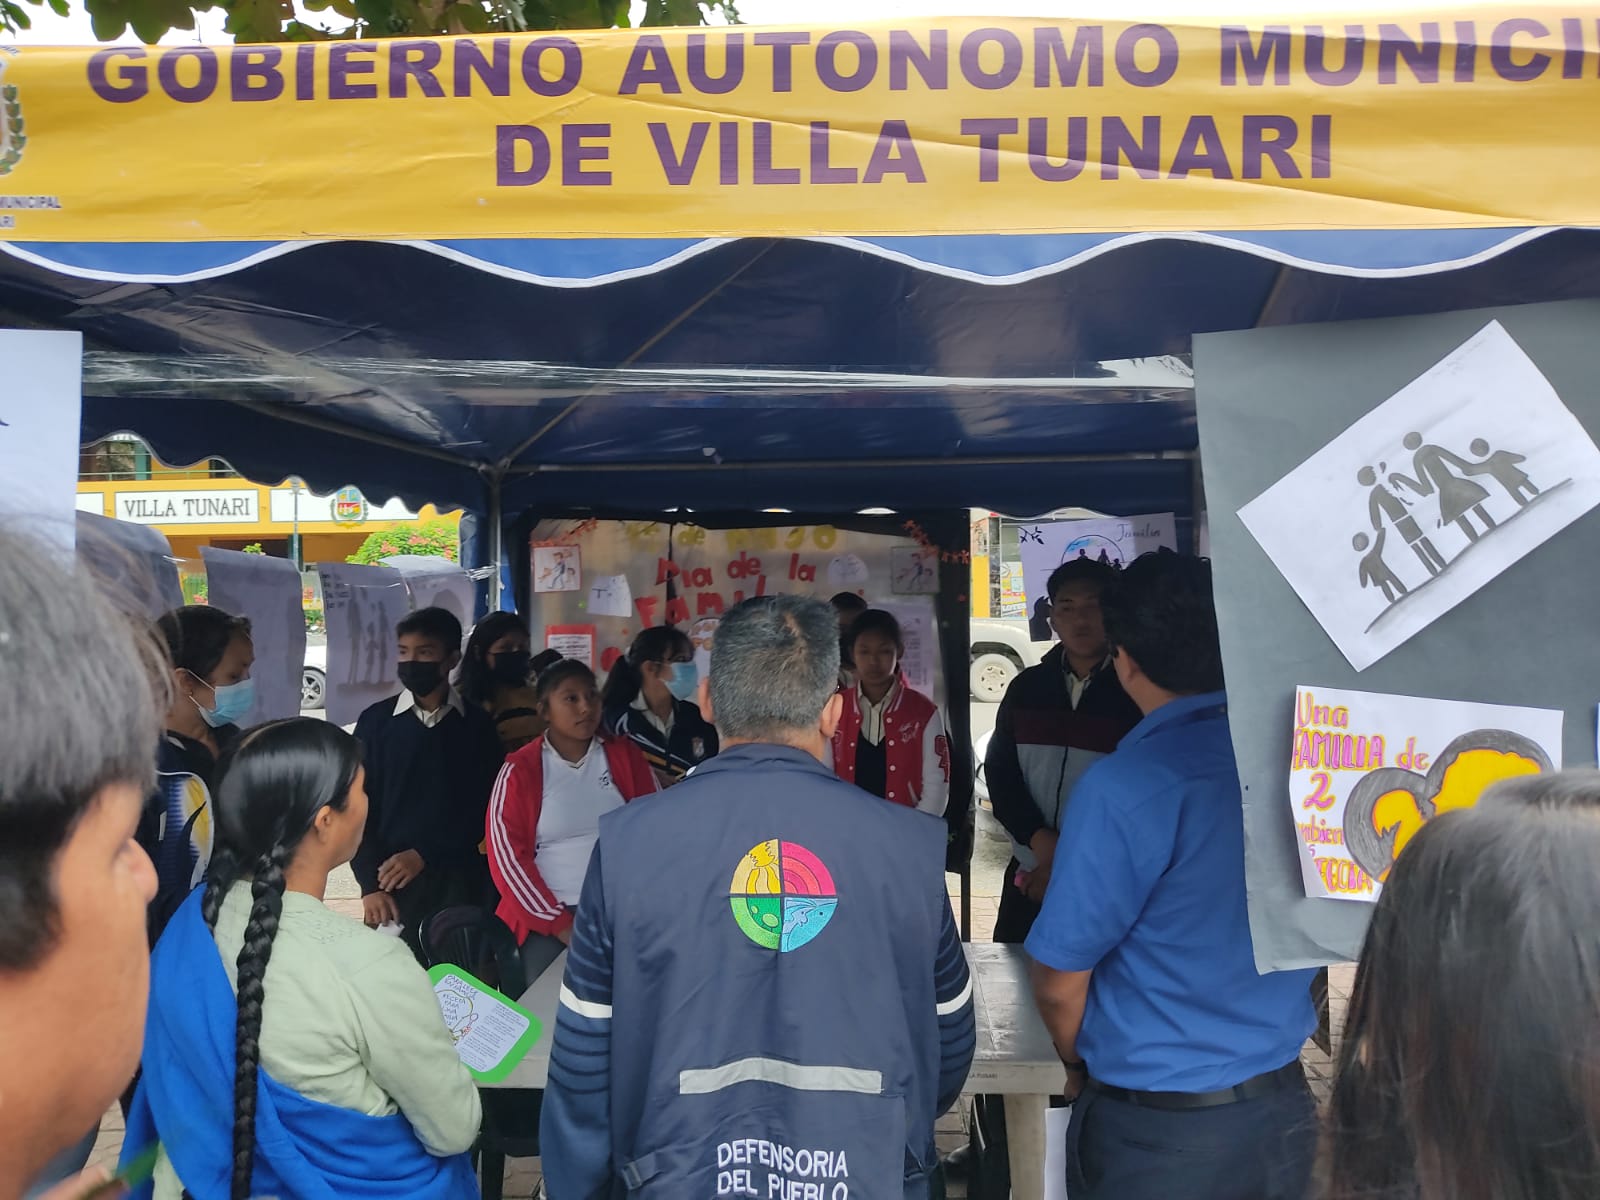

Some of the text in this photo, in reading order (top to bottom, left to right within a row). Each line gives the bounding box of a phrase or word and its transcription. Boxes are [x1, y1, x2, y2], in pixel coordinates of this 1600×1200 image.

[87, 17, 1600, 104] GOBIERNO AUTONOMO MUNICI
[496, 114, 1333, 187] DE VILLA TUNARI
[124, 498, 250, 517] VILLA TUNARI
[727, 551, 762, 580] de
[788, 553, 816, 582] la
[1297, 692, 1348, 728] Una
[1396, 736, 1429, 770] de
[1303, 772, 1336, 811] 2
[717, 1138, 848, 1178] DEFENSORIA
[717, 1169, 848, 1200] DEL PUEBLO
